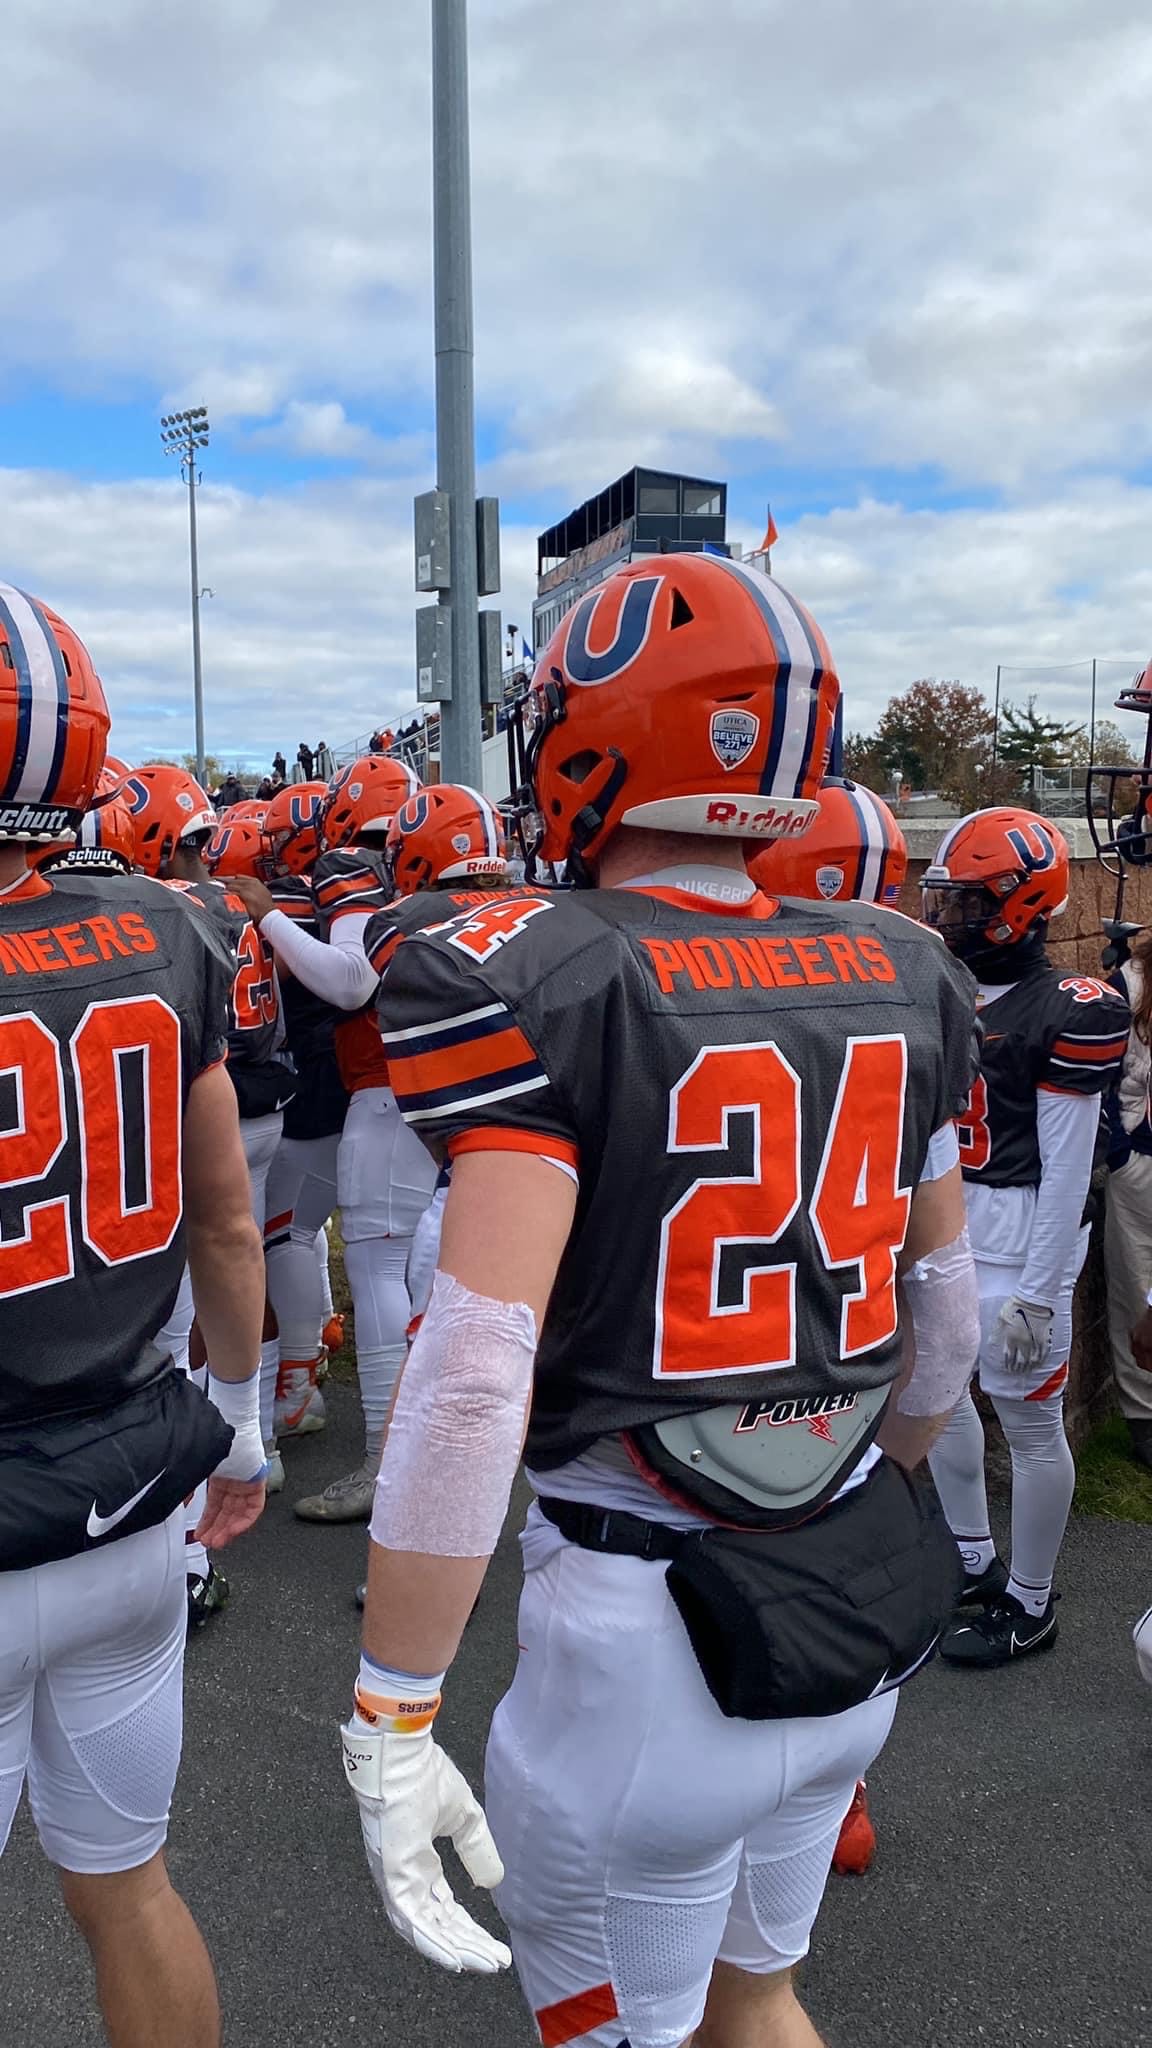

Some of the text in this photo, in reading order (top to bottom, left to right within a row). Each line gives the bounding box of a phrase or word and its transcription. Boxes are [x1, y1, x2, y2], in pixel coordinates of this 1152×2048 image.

[563, 576, 666, 687] U
[713, 731, 754, 744] BELIEVE
[725, 741, 740, 750] 271
[0, 805, 69, 830] chutt
[399, 792, 429, 835] U
[706, 801, 819, 834] Riddell
[66, 847, 113, 862] schutt
[1004, 822, 1056, 873] U
[639, 932, 897, 994] PIONEERS
[652, 1032, 912, 1380] 24
[733, 1390, 860, 1434] POWER
